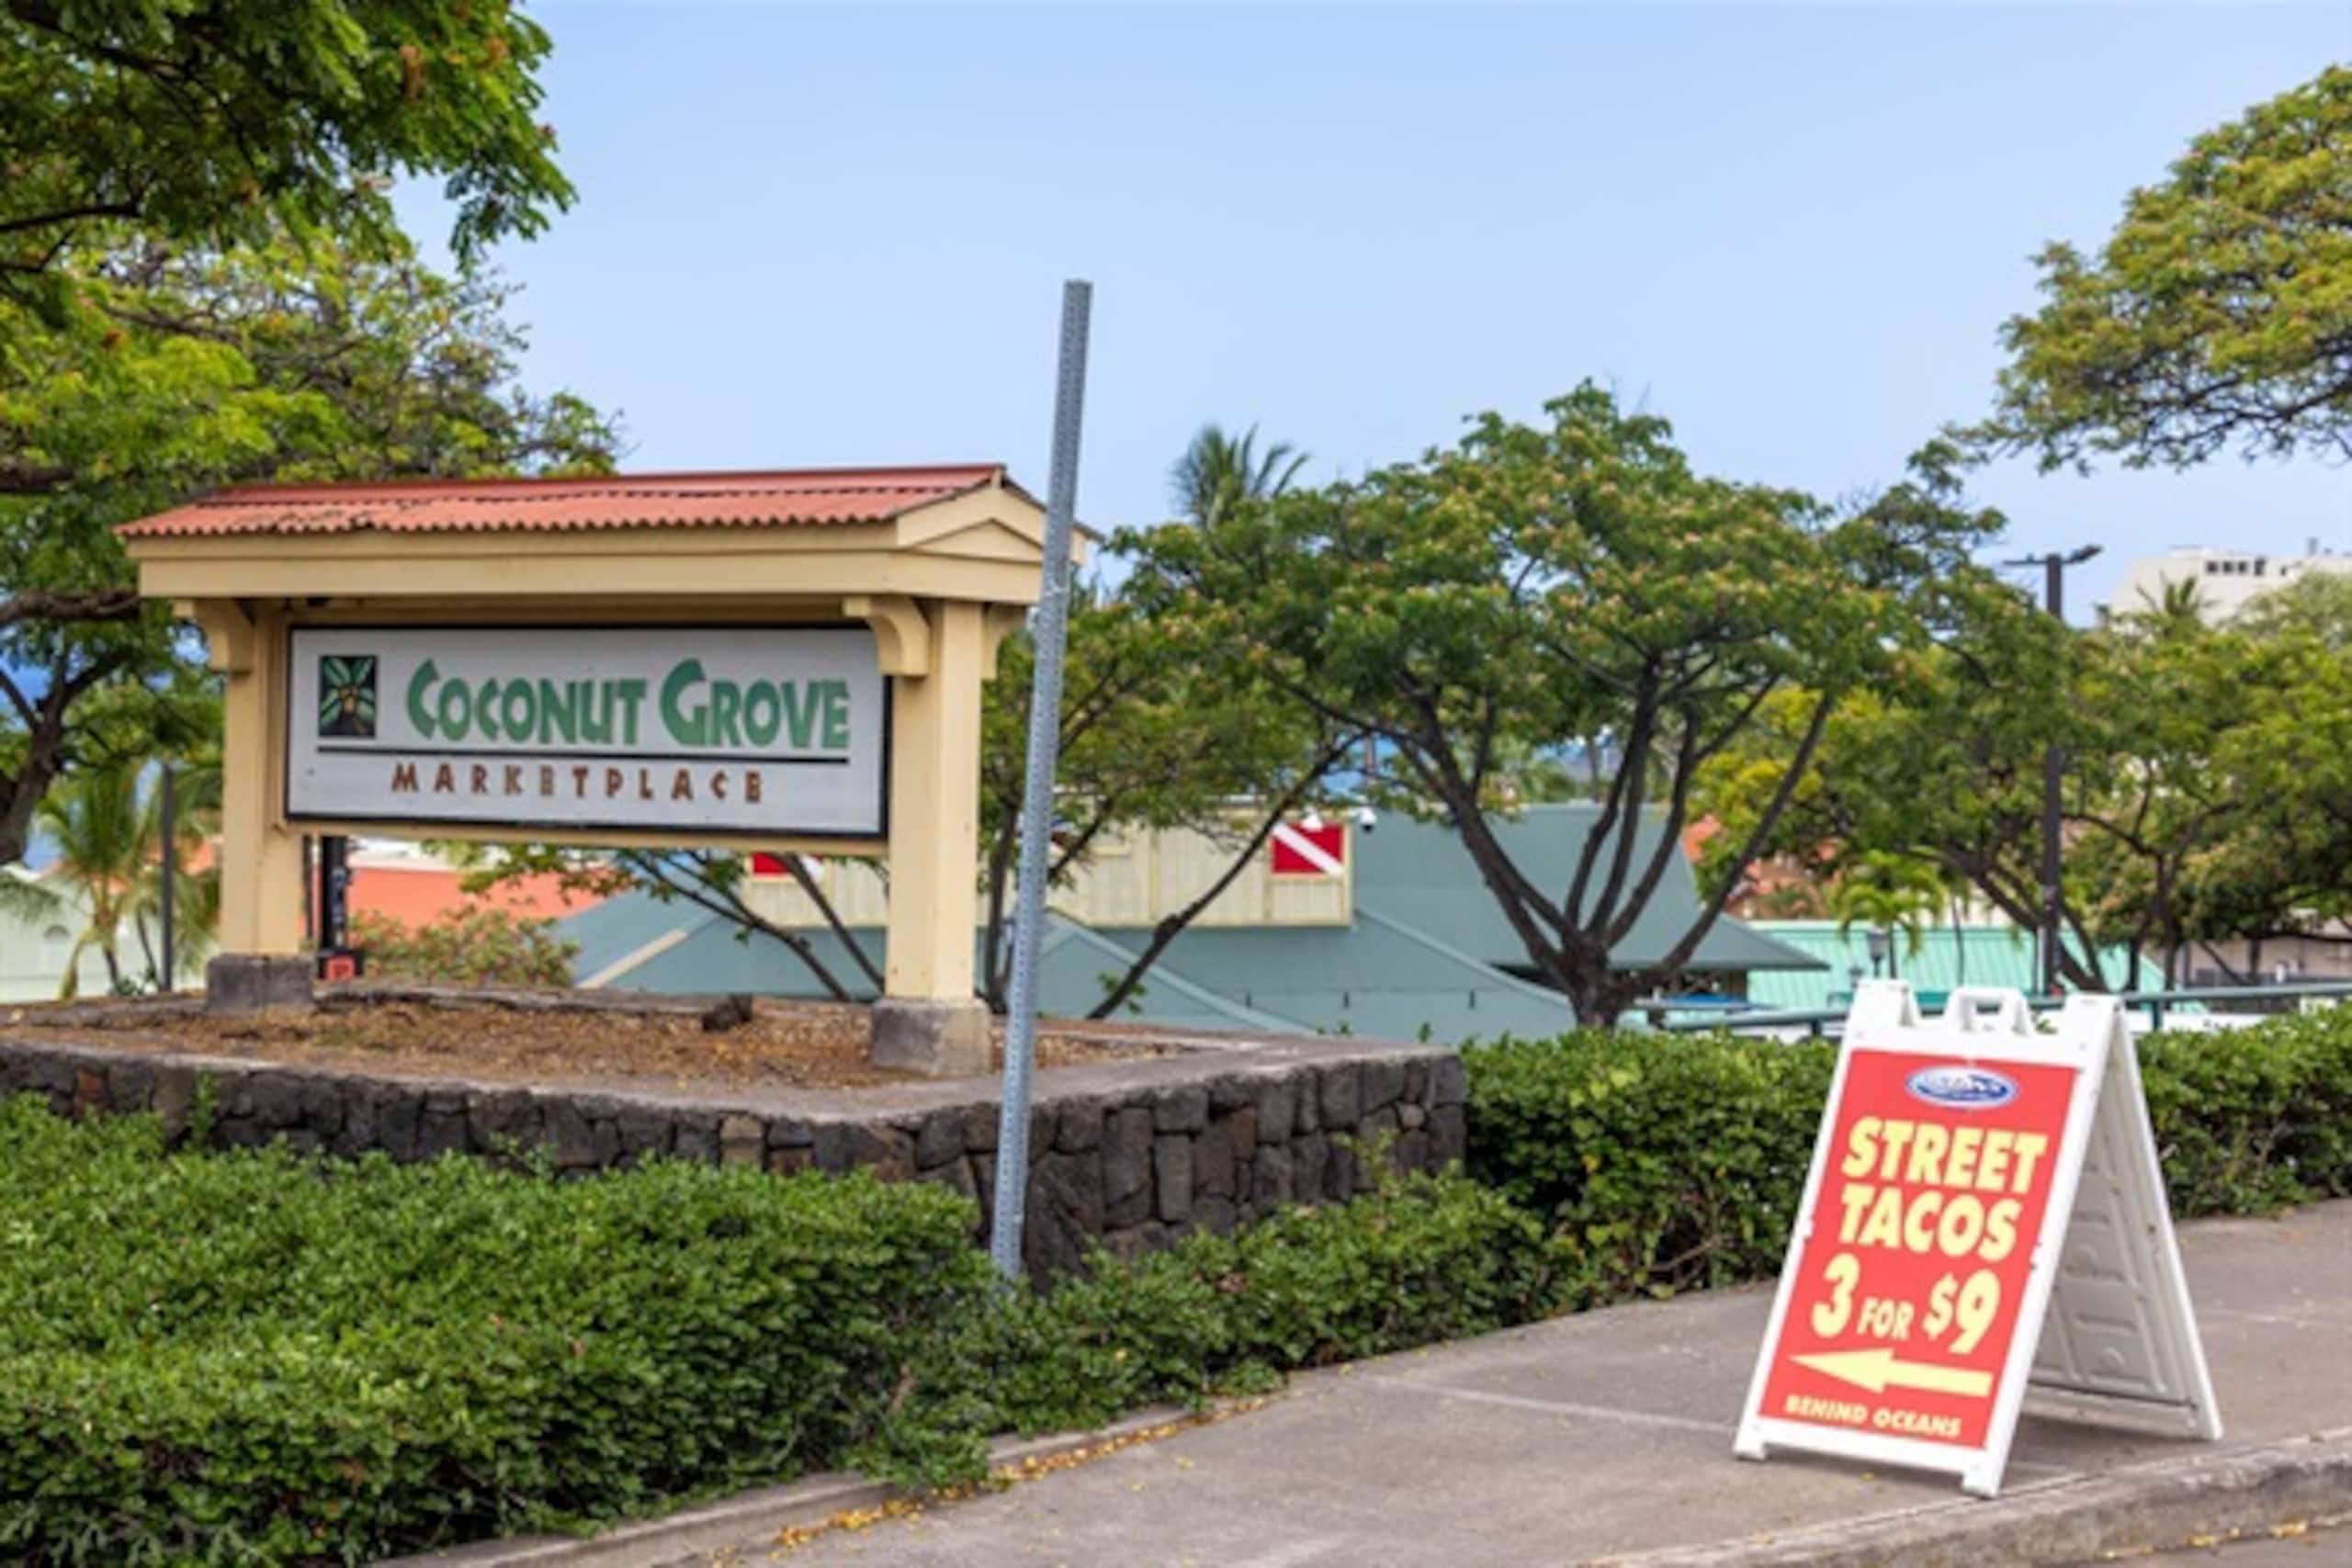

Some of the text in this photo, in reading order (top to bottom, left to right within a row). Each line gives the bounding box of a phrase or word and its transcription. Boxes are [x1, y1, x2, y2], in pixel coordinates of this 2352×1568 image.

[406, 659, 849, 749] COCONUT GROVE
[391, 762, 762, 804] MARKETPLACE
[1841, 1116, 2048, 1194] STREET
[1838, 1183, 2022, 1261] TACOS
[1812, 1253, 2000, 1355] 3 FOR $9
[1785, 1393, 1962, 1438] BEHIND OCEANS
